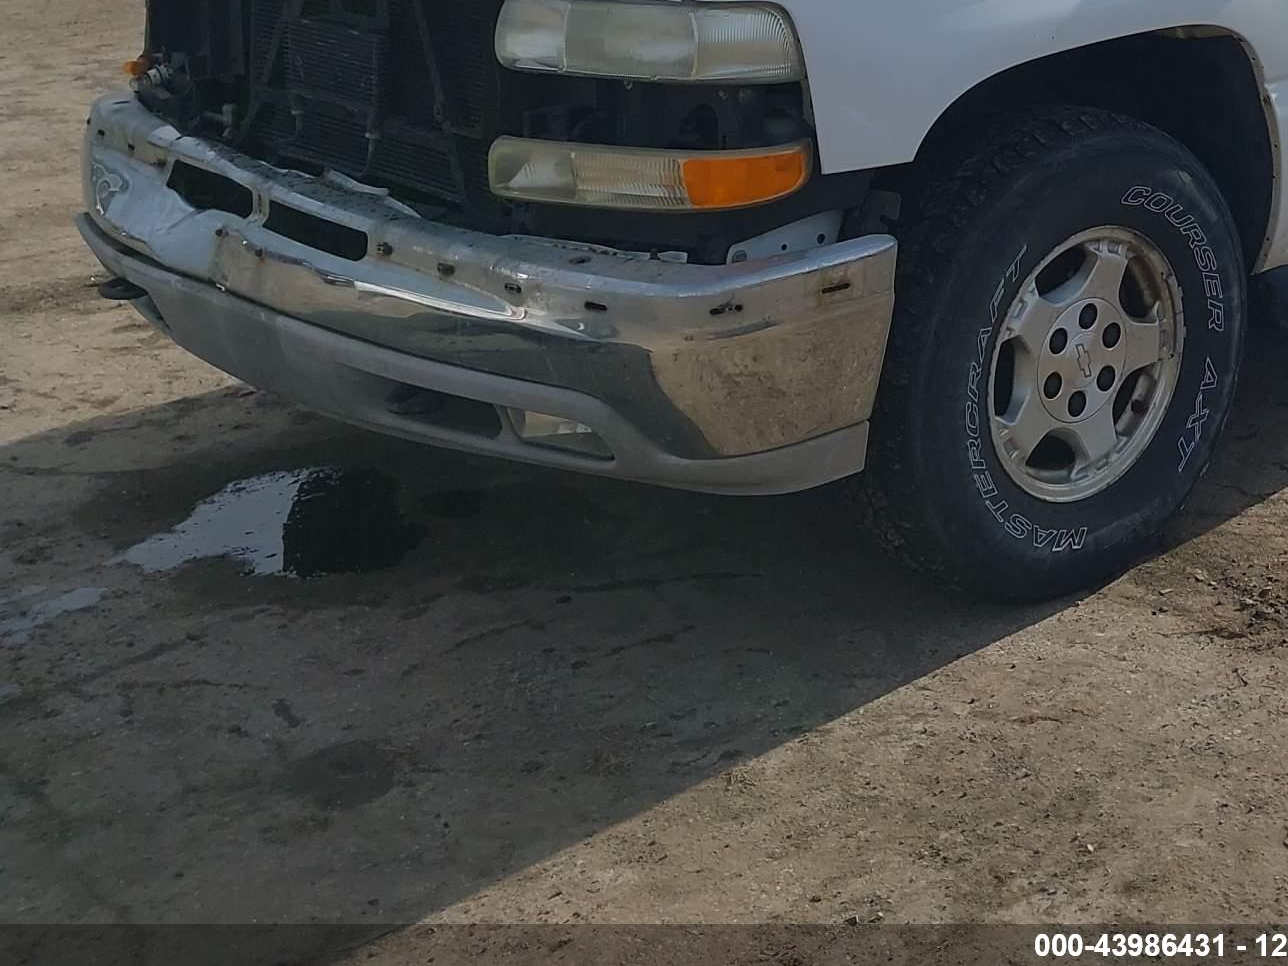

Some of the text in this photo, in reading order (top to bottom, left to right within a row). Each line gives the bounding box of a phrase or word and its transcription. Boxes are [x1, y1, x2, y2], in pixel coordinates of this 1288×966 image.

[965, 242, 1088, 553] MASTERCRAFT
[1121, 185, 1224, 474] COURSER AXT
